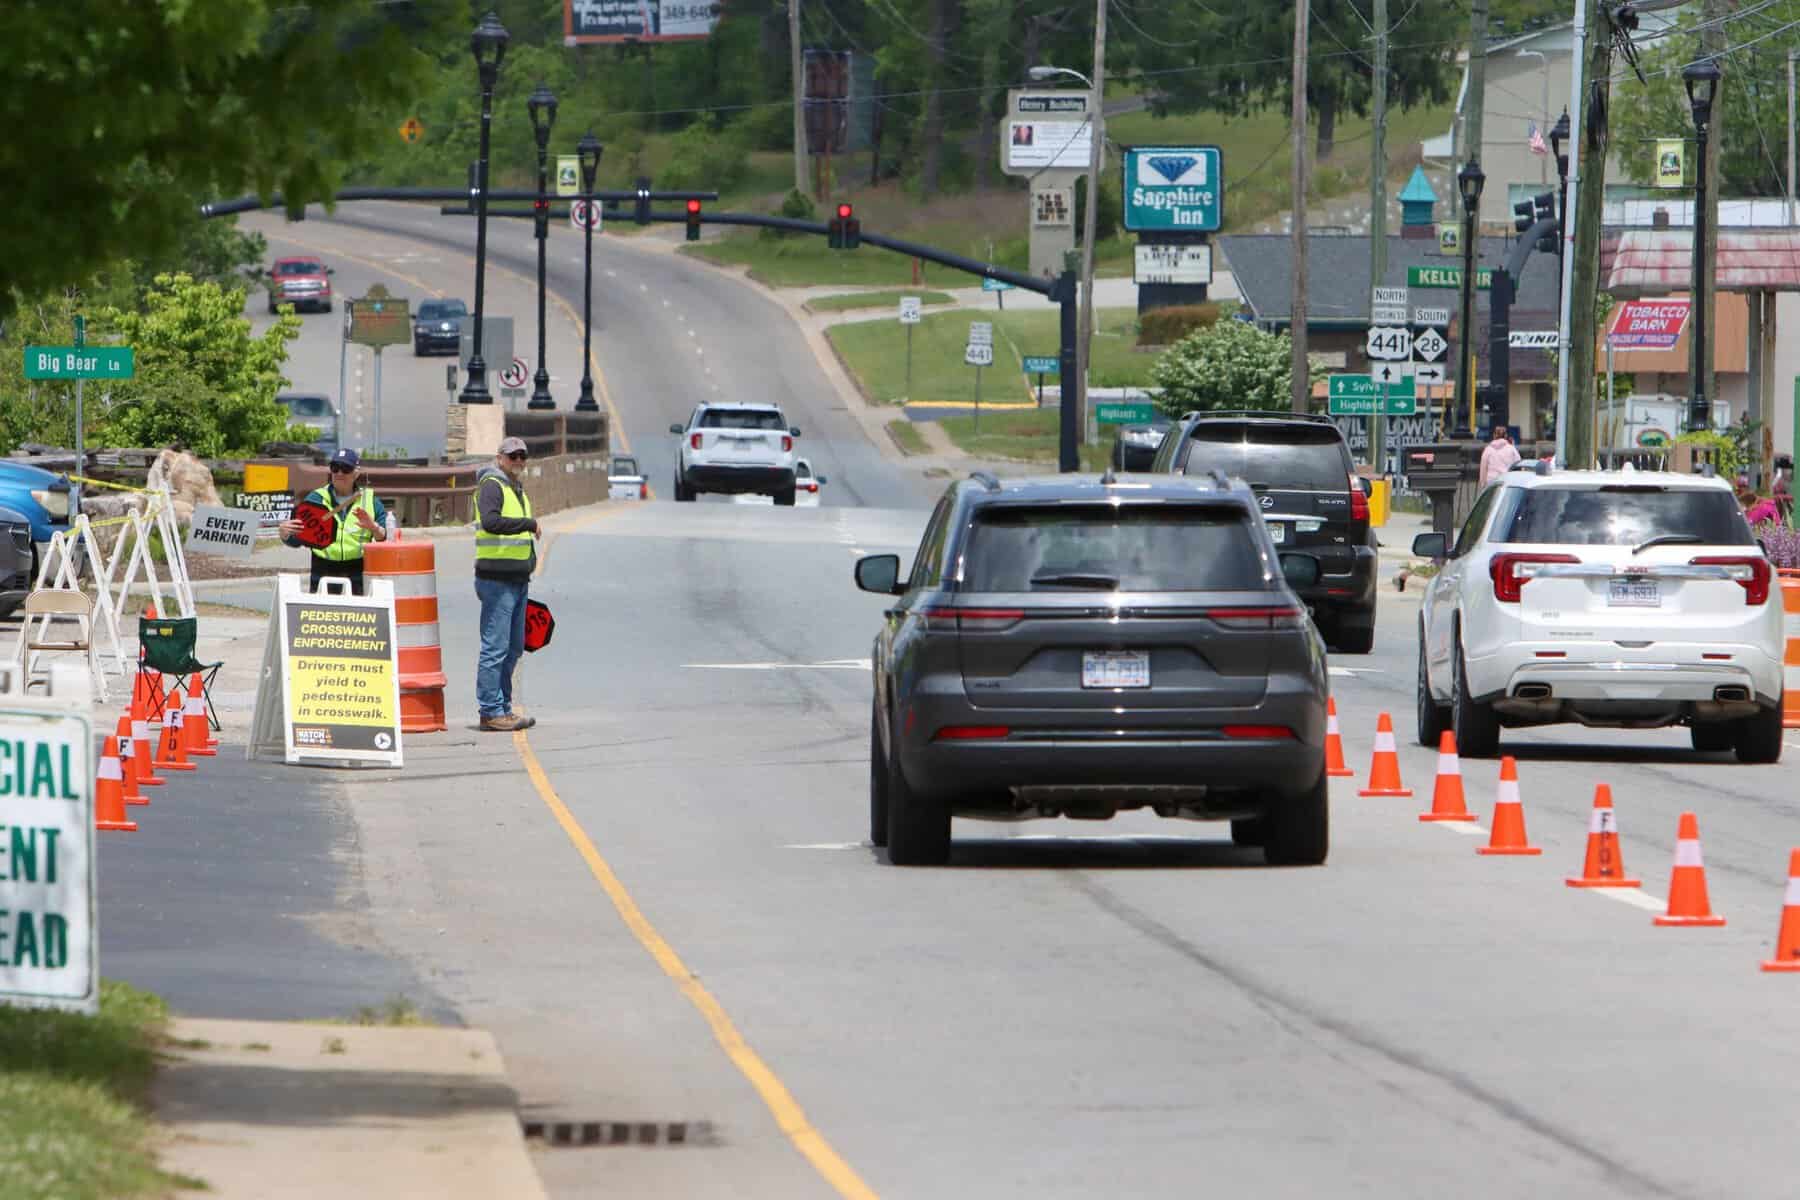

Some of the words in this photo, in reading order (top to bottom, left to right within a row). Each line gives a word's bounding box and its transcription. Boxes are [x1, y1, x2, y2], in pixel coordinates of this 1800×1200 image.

[1132, 187, 1213, 210] Sapphire
[1173, 207, 1204, 225] Inn
[1418, 269, 1462, 286] KELLY
[1375, 289, 1406, 301] NORTH
[903, 309, 919, 320] 45
[1417, 310, 1447, 321] SOUTH
[1625, 306, 1687, 318] TOBACCO
[1629, 319, 1669, 330] BARN
[1371, 332, 1405, 353] 441
[1420, 338, 1441, 353] 28
[967, 348, 990, 361] 441
[38, 353, 60, 374] Big
[66, 353, 98, 371] Bear
[108, 359, 120, 371] Ln
[1352, 381, 1381, 393] Sylva
[205, 516, 246, 532] EVENT
[193, 528, 250, 546] PARKING
[300, 610, 377, 624] PEDESTRIAN
[301, 623, 378, 638] CROSSWALK
[293, 637, 388, 652] ENFORCEMENT
[298, 659, 346, 673] Drivers
[350, 664, 385, 674] must
[316, 676, 349, 688] yield
[353, 677, 367, 688] to
[302, 691, 383, 705] pedestrians
[298, 706, 310, 716] in
[315, 707, 388, 720] crosswalk.
